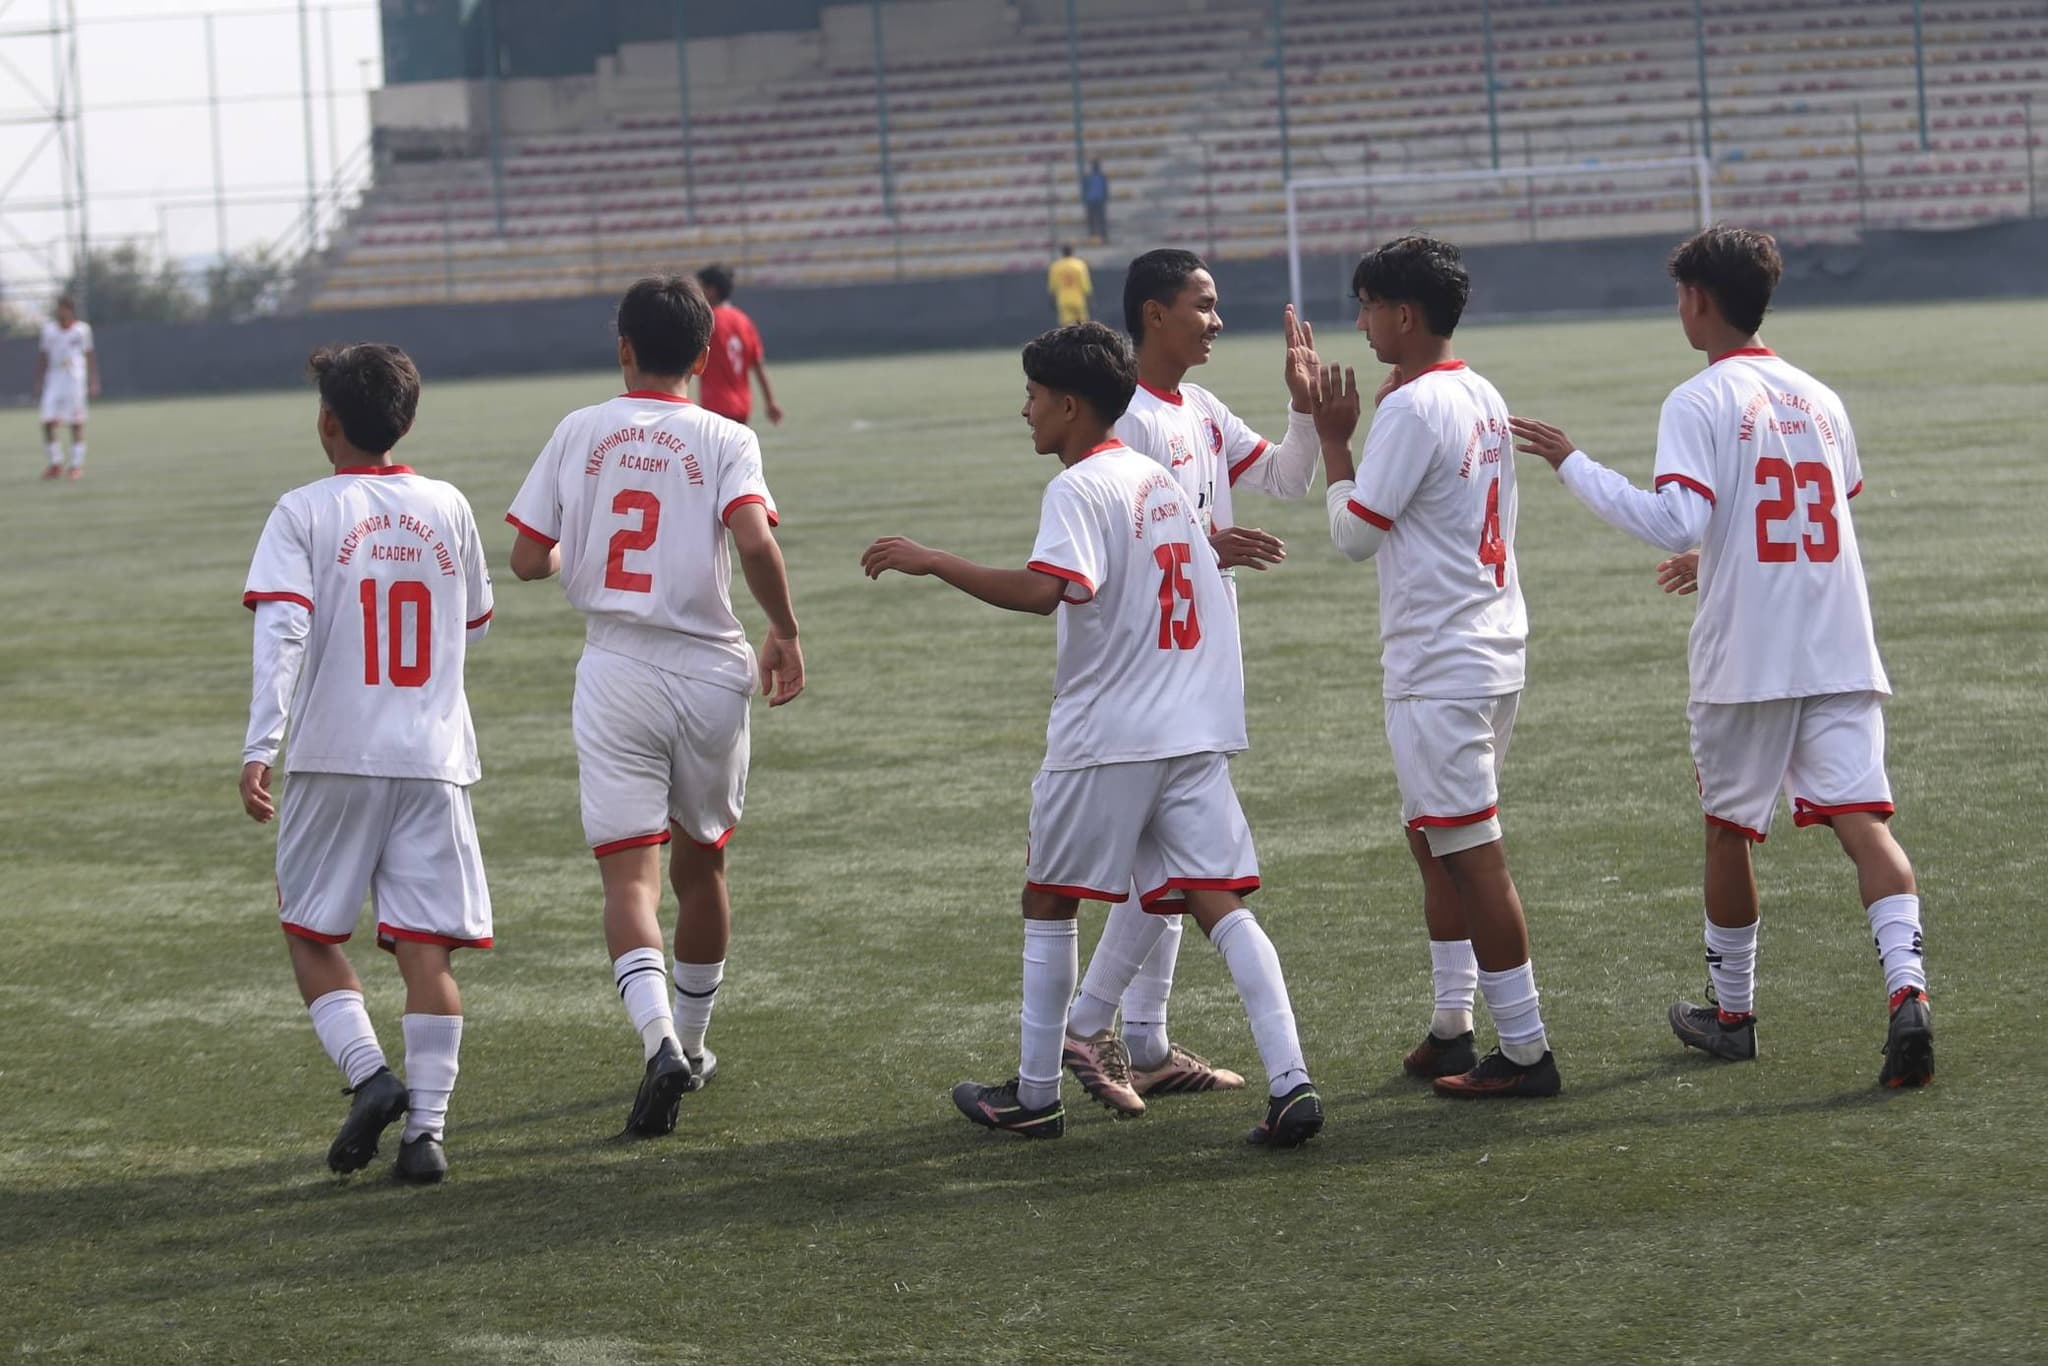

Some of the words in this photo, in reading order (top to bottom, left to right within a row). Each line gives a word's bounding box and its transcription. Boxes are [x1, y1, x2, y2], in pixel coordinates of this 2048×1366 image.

[1768, 417, 1807, 435] ACDEMY
[1779, 392, 1812, 415] PEACE
[1815, 413, 1835, 446] POINT
[585, 428, 645, 476] MACHHINDRA
[652, 431, 686, 454] PEACE
[681, 454, 704, 486] POINT
[619, 454, 670, 473] ACADEMY
[1755, 457, 1840, 562] 23
[337, 514, 391, 565] MACHHINDRA
[400, 514, 435, 543] PEACE
[432, 541, 456, 576] POINT
[371, 544, 423, 562] ACADEMY
[604, 488, 660, 593] 2
[1153, 542, 1201, 650] 15
[360, 578, 431, 687] 10
